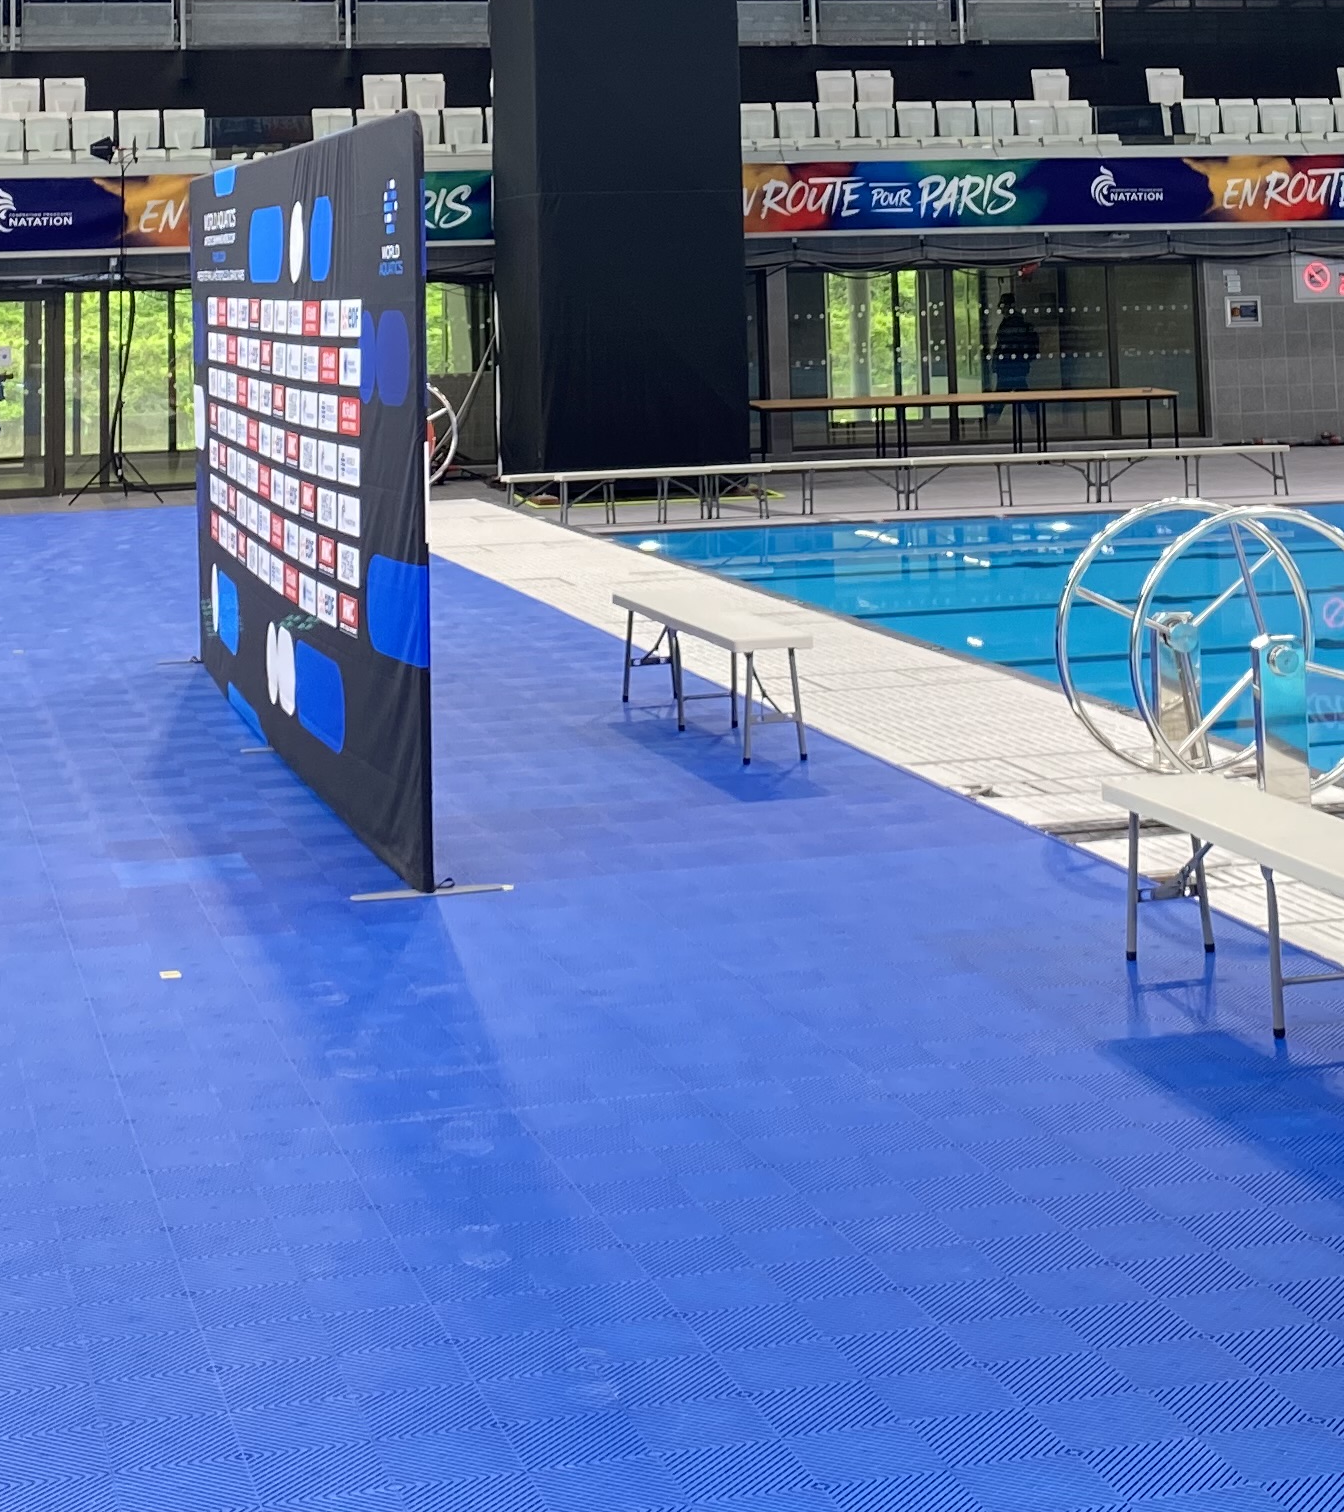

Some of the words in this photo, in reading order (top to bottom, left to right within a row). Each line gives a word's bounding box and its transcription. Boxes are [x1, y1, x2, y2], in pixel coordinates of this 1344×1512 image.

[424, 185, 472, 229] RIS
[760, 176, 867, 219] ROUTE
[871, 188, 913, 207] POUR
[918, 170, 1017, 219] PARIS
[1110, 192, 1164, 202] NATATION
[1223, 177, 1259, 210] EN
[9, 216, 73, 227] NATATION
[139, 193, 189, 234] EN
[381, 244, 401, 260] WORLD
